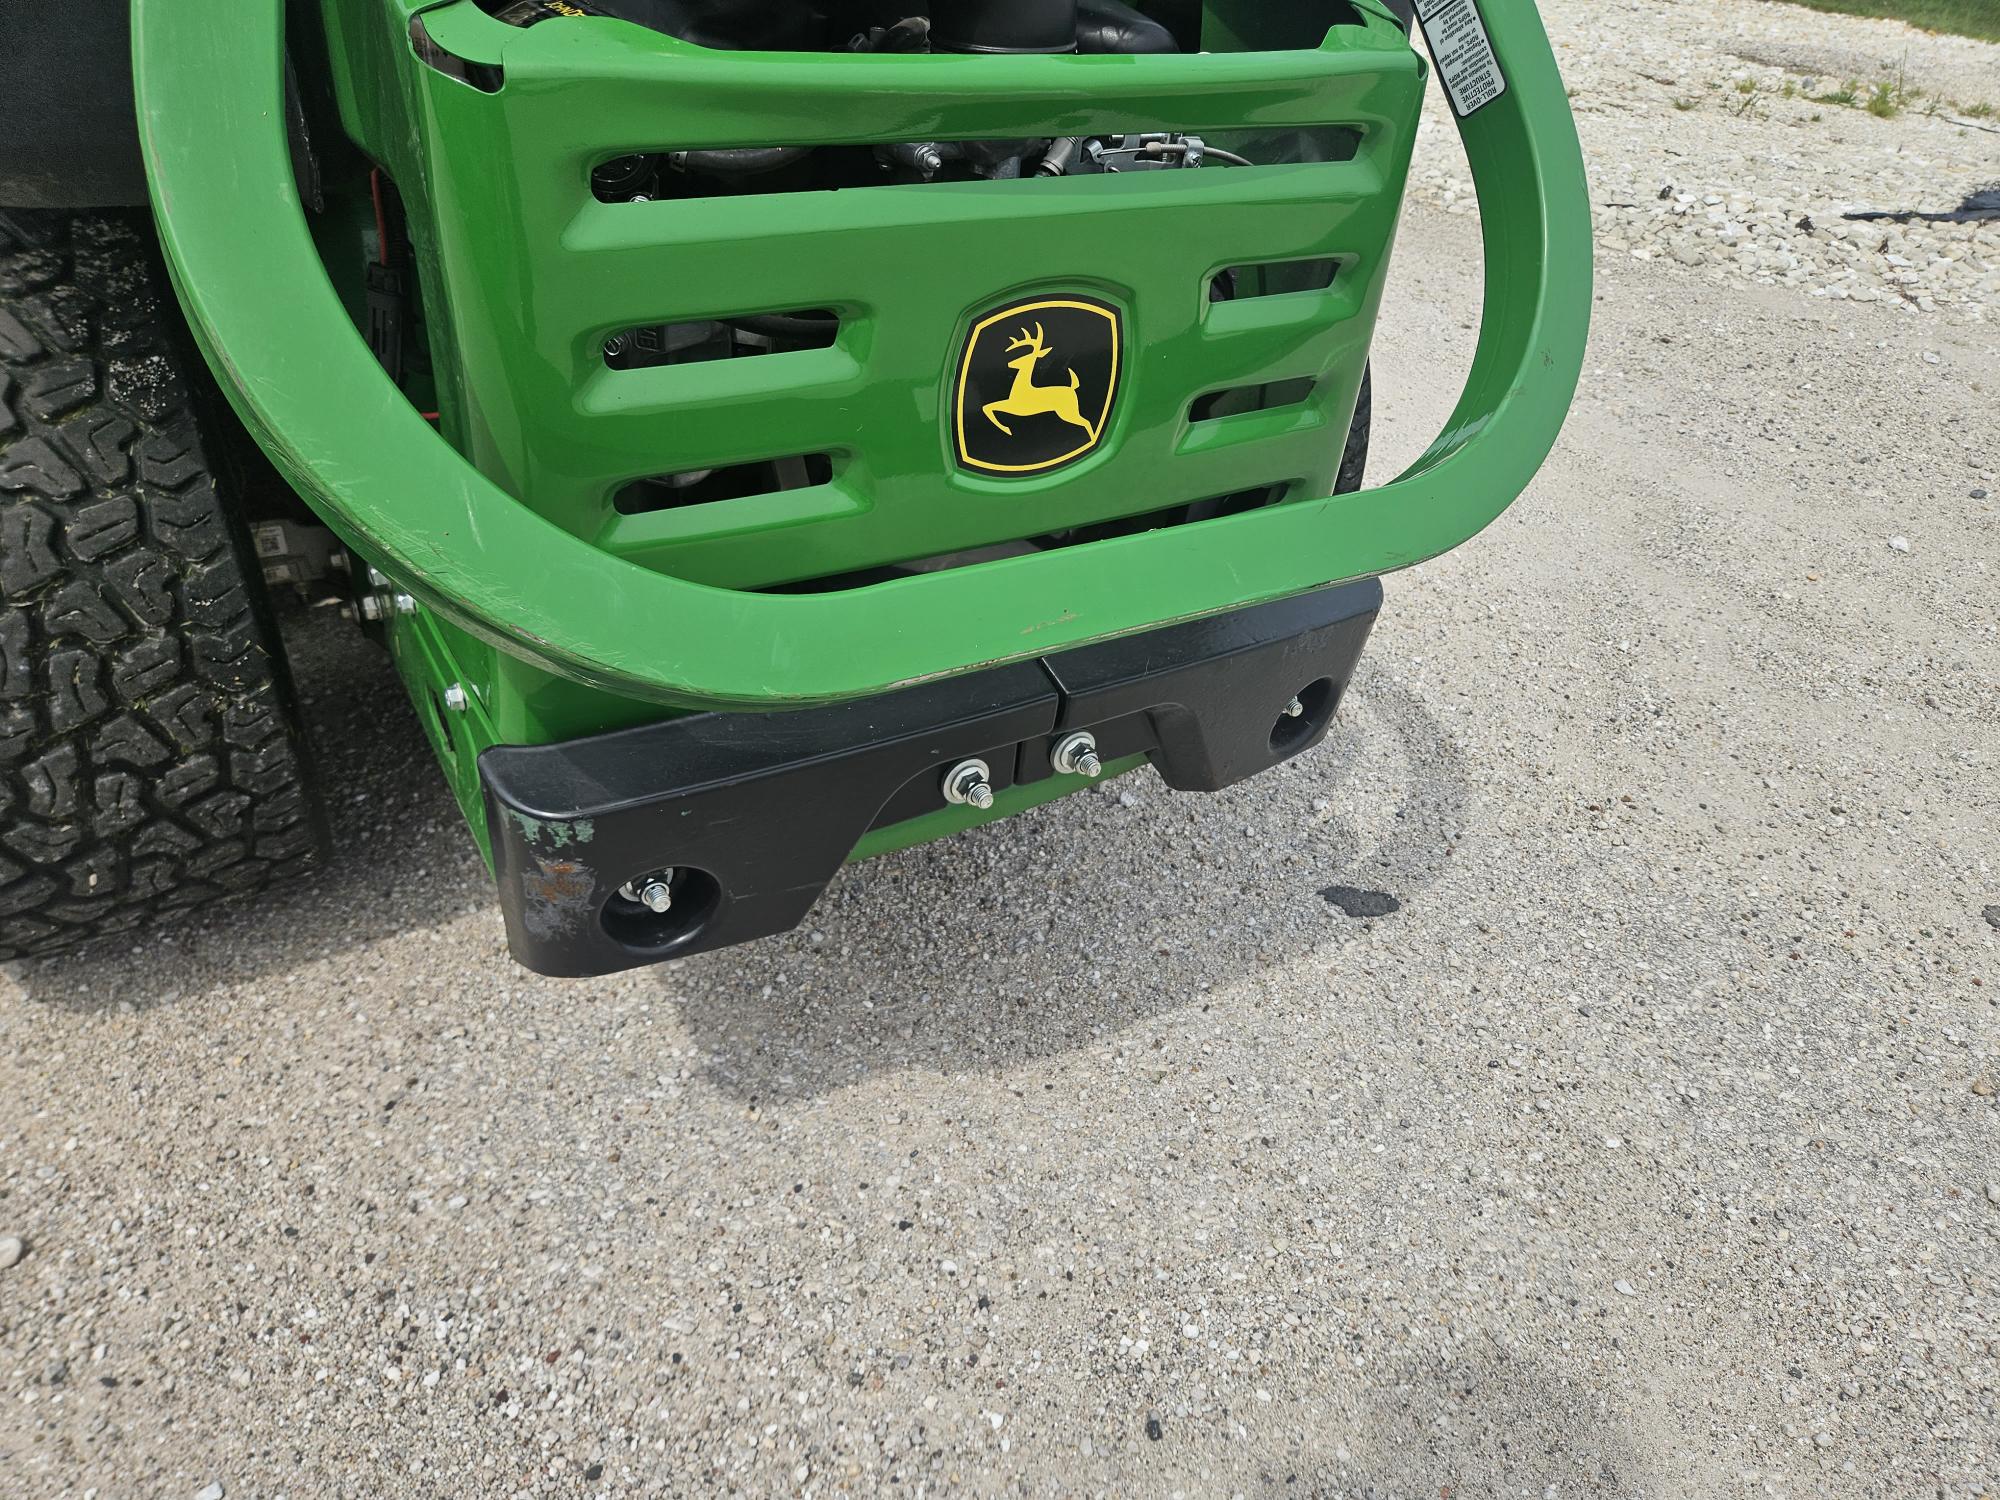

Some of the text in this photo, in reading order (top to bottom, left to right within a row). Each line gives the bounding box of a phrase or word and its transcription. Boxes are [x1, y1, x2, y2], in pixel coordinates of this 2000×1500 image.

[1458, 12, 1470, 23] ROPS
[1449, 72, 1460, 83] ROPS
[1458, 70, 1491, 95] STRUCTURE
[1461, 78, 1495, 103] PROTECTIVE
[1466, 86, 1496, 110] ROLL-OVER
